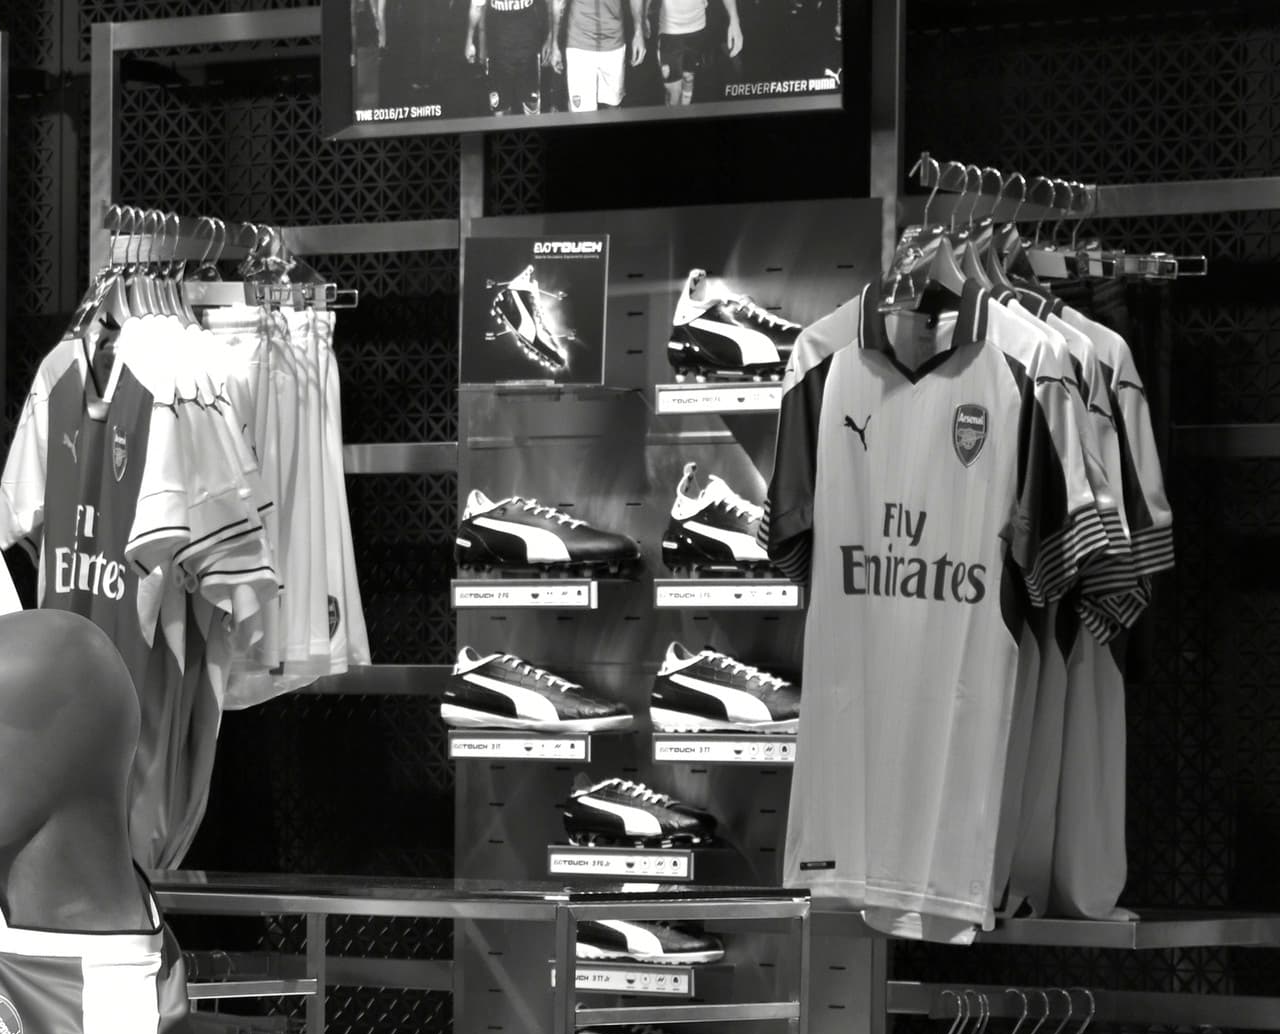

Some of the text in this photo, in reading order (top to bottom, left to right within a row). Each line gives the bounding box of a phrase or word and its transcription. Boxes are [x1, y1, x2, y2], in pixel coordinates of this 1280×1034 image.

[355, 104, 442, 122] THE 2016/17 SHIRTS
[883, 502, 928, 547] Fly
